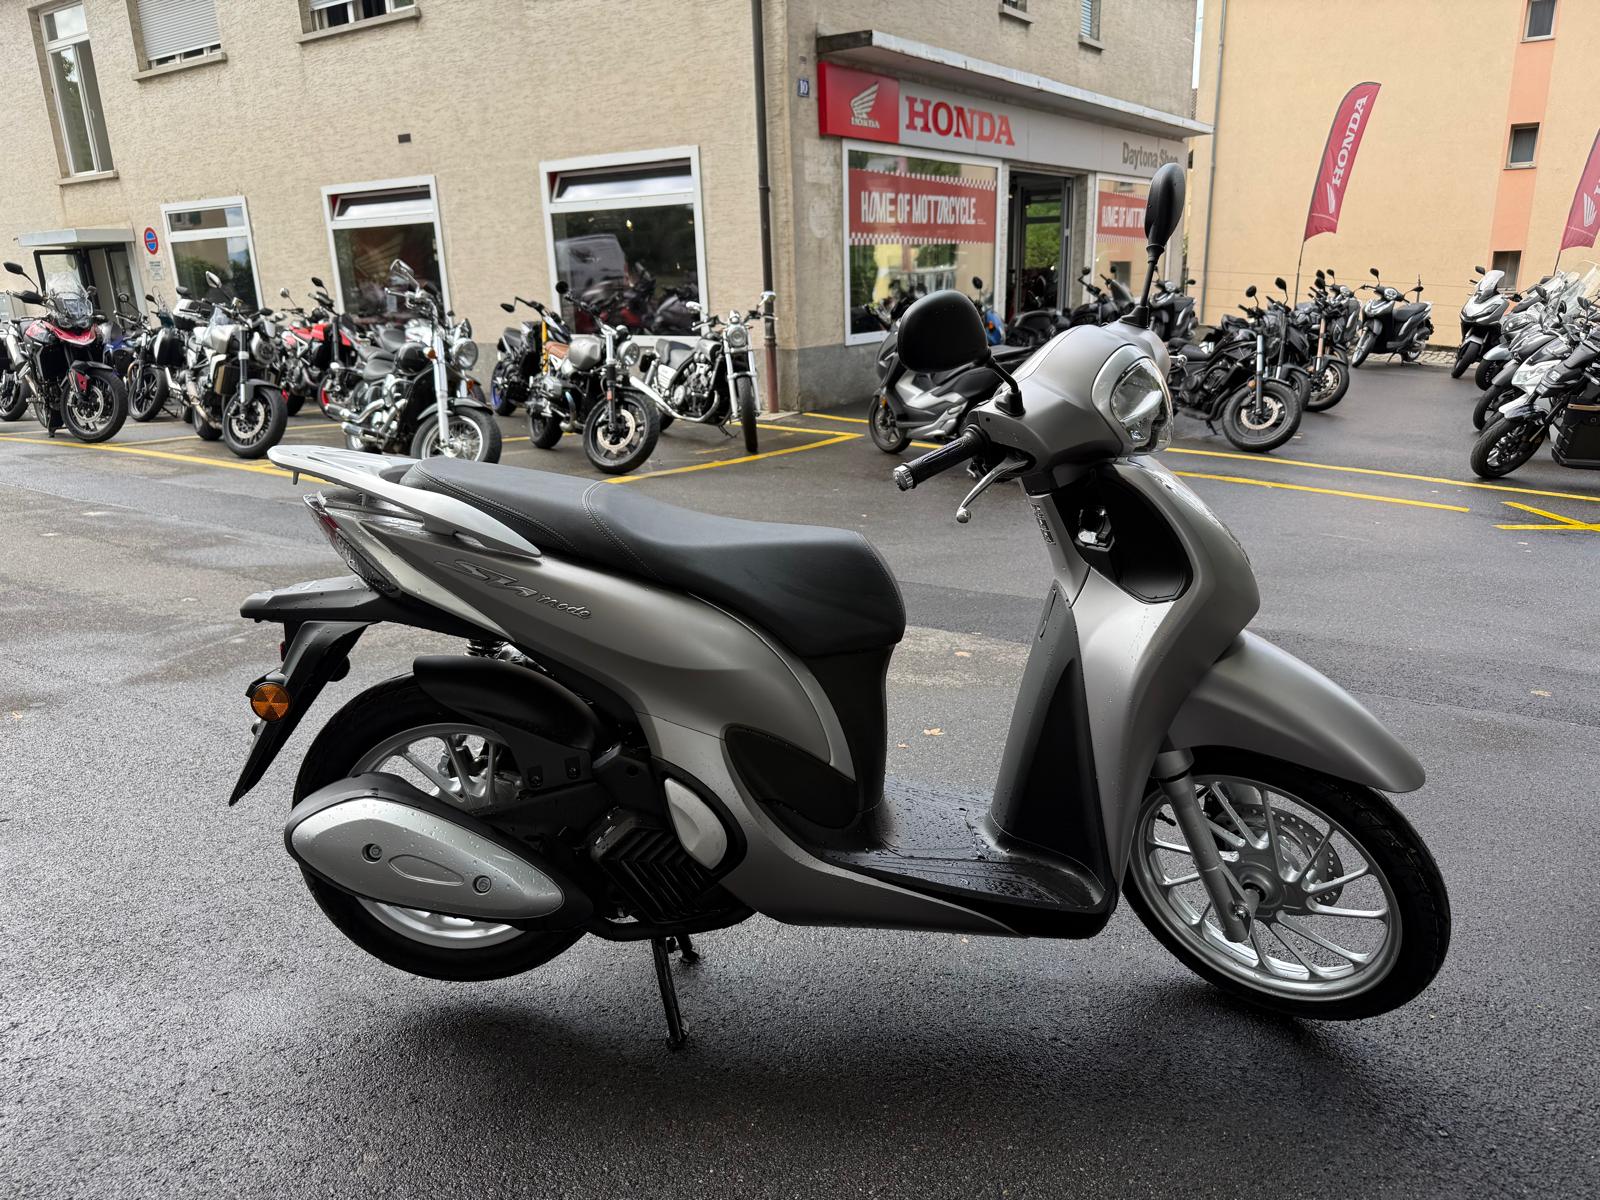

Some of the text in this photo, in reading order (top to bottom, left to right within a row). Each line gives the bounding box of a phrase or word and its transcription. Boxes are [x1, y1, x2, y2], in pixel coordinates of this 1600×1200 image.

[850, 116, 880, 129] HONDA
[904, 95, 1015, 146] HONDA
[1122, 141, 1158, 170] Daytona
[1332, 95, 1368, 188] HONDA
[860, 191, 896, 224] HOME
[897, 192, 911, 224] OF
